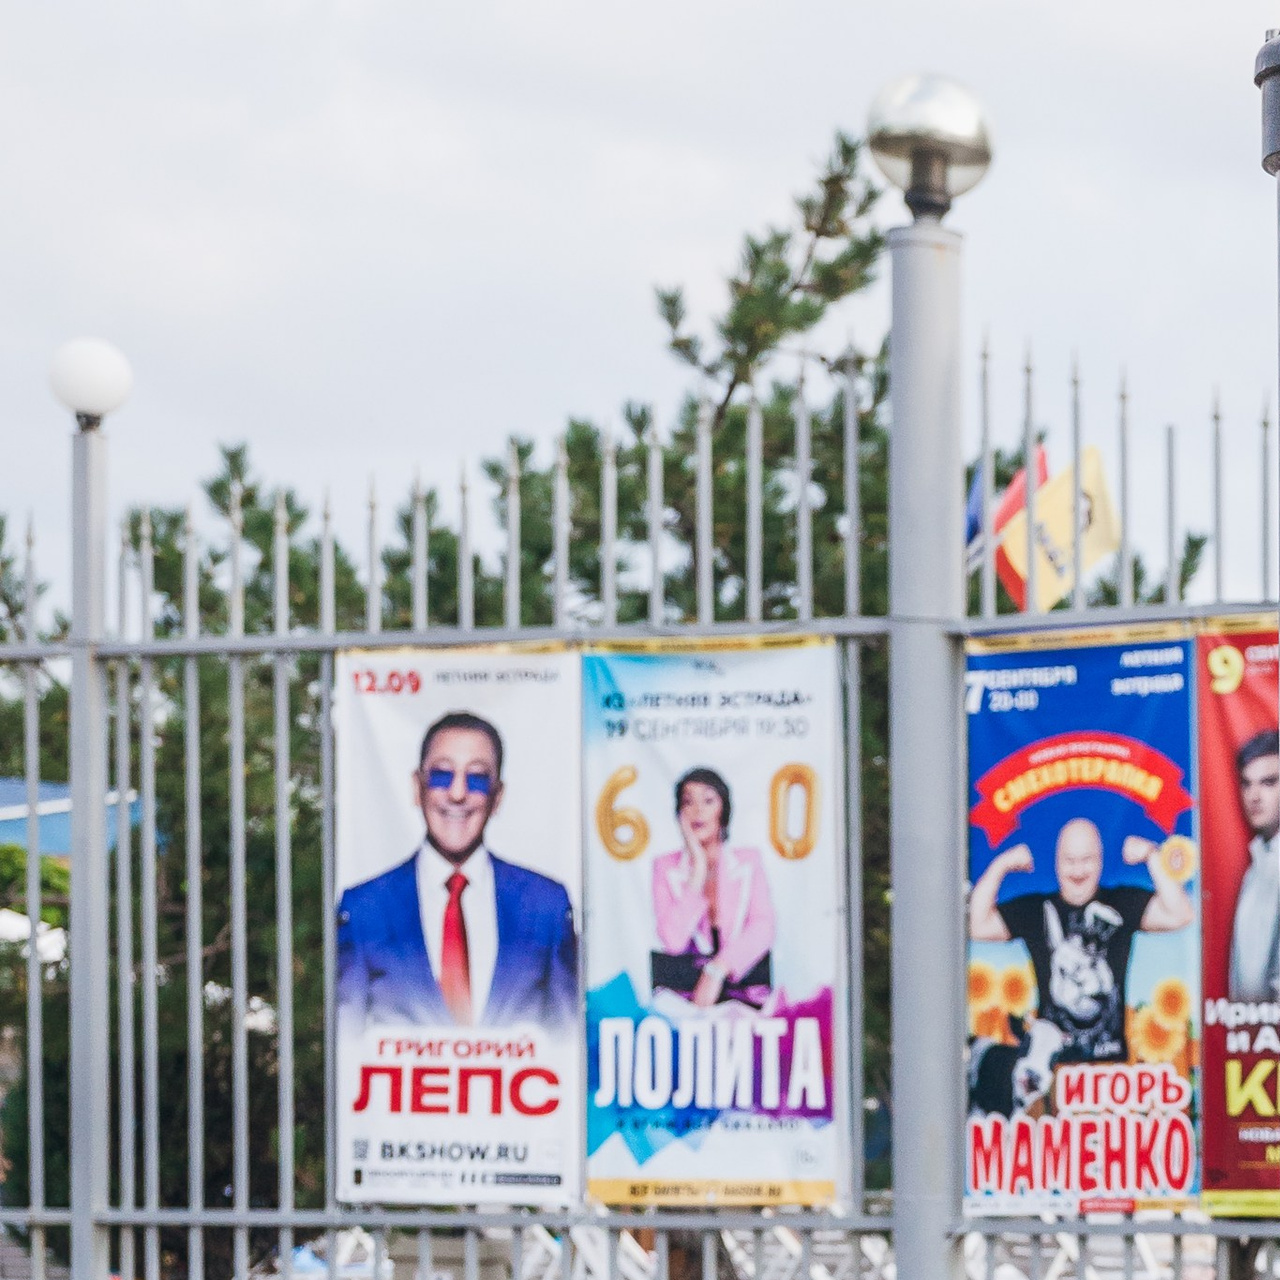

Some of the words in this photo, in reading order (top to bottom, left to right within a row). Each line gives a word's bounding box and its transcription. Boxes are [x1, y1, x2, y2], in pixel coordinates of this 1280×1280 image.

[353, 670, 422, 695] 12.09
[965, 669, 986, 715] 7
[1207, 644, 1245, 695] 9
[378, 1036, 536, 1058] ГРИГОРИЙ
[594, 1015, 826, 1110] ЛОЛИТА
[353, 1065, 560, 1116] ЛЕПС
[1064, 1070, 1185, 1106] ИГОРЬ
[971, 1116, 1190, 1196] МАМЕНКО
